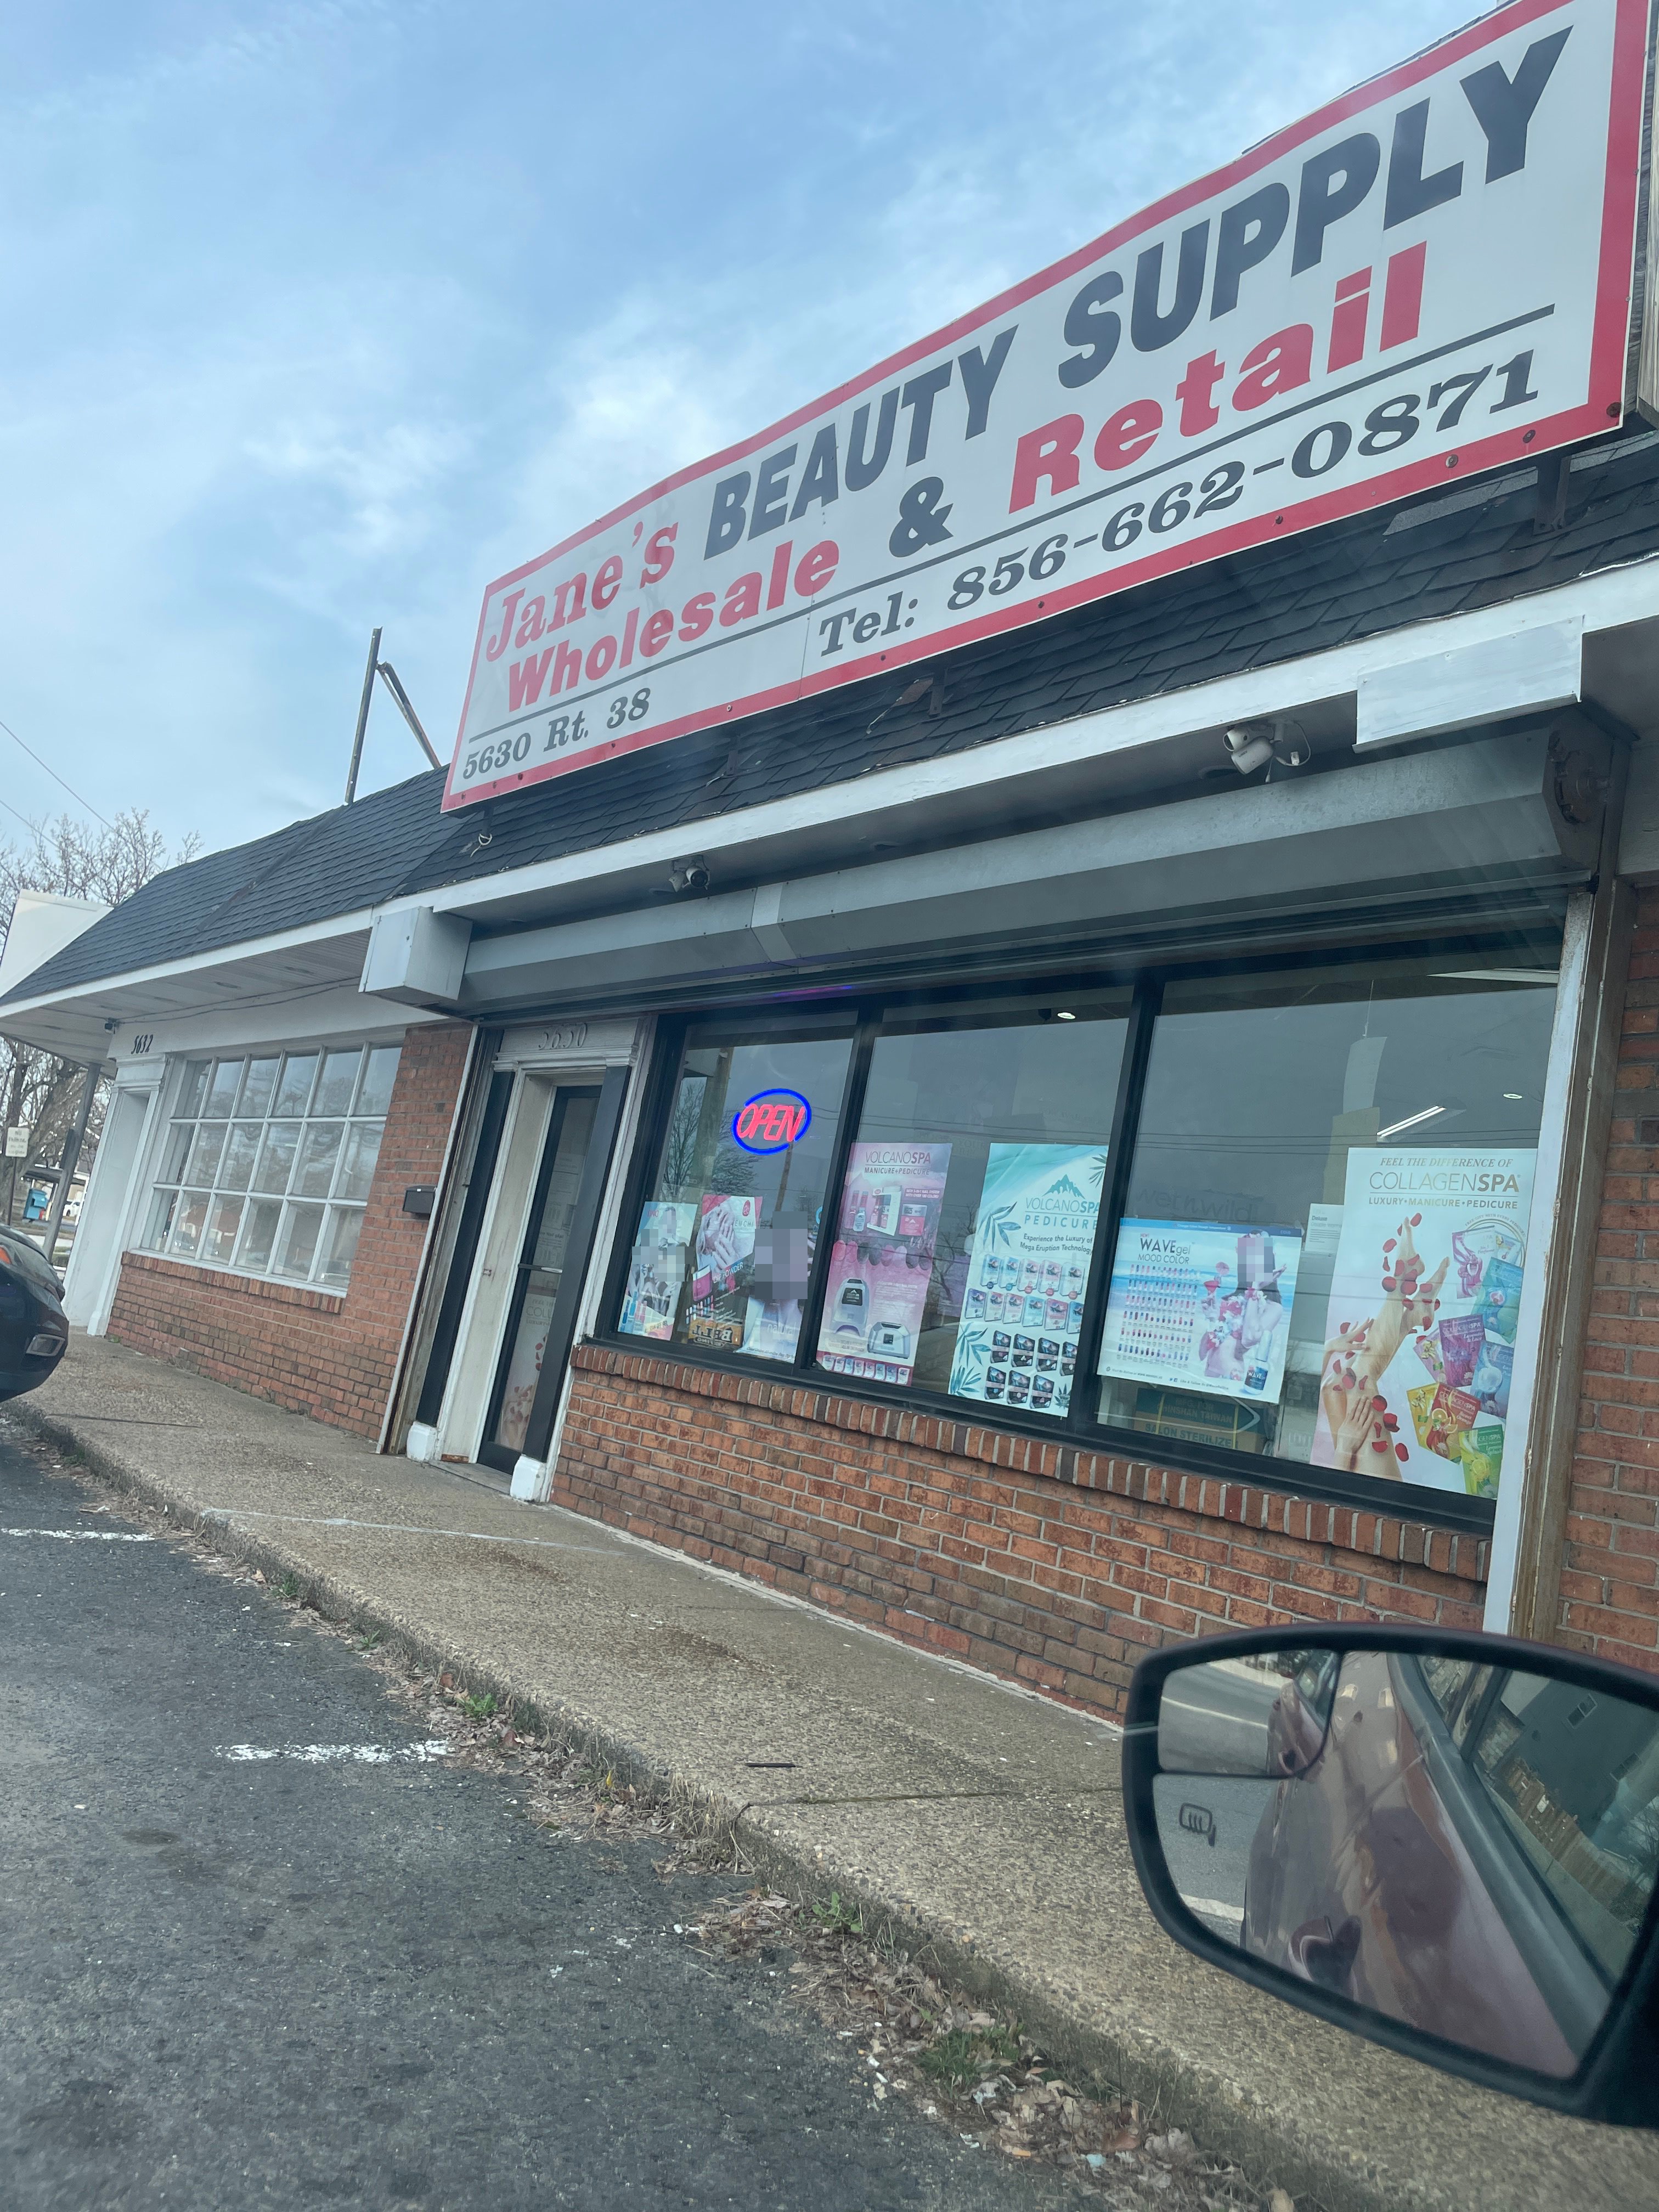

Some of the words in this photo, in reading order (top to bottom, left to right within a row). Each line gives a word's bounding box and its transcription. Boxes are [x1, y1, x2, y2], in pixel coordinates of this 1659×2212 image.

[486, 522, 679, 662] Jane's
[704, 324, 1019, 560] BEAUTY
[1058, 24, 1573, 389] SUPPLY
[508, 540, 839, 712] Wholesale
[889, 477, 953, 557] &
[1008, 240, 1427, 515] Retail
[820, 591, 918, 657] Tel:
[947, 349, 1539, 611] 856-662-0871
[462, 733, 531, 779] 5630
[543, 709, 588, 752] Rt.
[606, 687, 651, 729] 38
[131, 1035, 154, 1054] 5632
[737, 1104, 805, 1142] OPEN
[866, 1151, 931, 1164] VOLCANOSPA
[1380, 1158, 1403, 1166] FEEL
[1407, 1158, 1427, 1166] THE
[1429, 1158, 1495, 1167] DIFFERENCE
[1498, 1159, 1513, 1167] OF
[1024, 1215, 1097, 1229] PEDICURE
[1024, 1233, 1053, 1242] Experience
[1066, 1235, 1085, 1243] Luxury
[1020, 1242, 1034, 1251] Mega
[1036, 1244, 1059, 1252] Eruption
[1062, 1244, 1092, 1255] Technology
[1138, 1254, 1161, 1262] MOOD
[1164, 1255, 1189, 1264] COLOR
